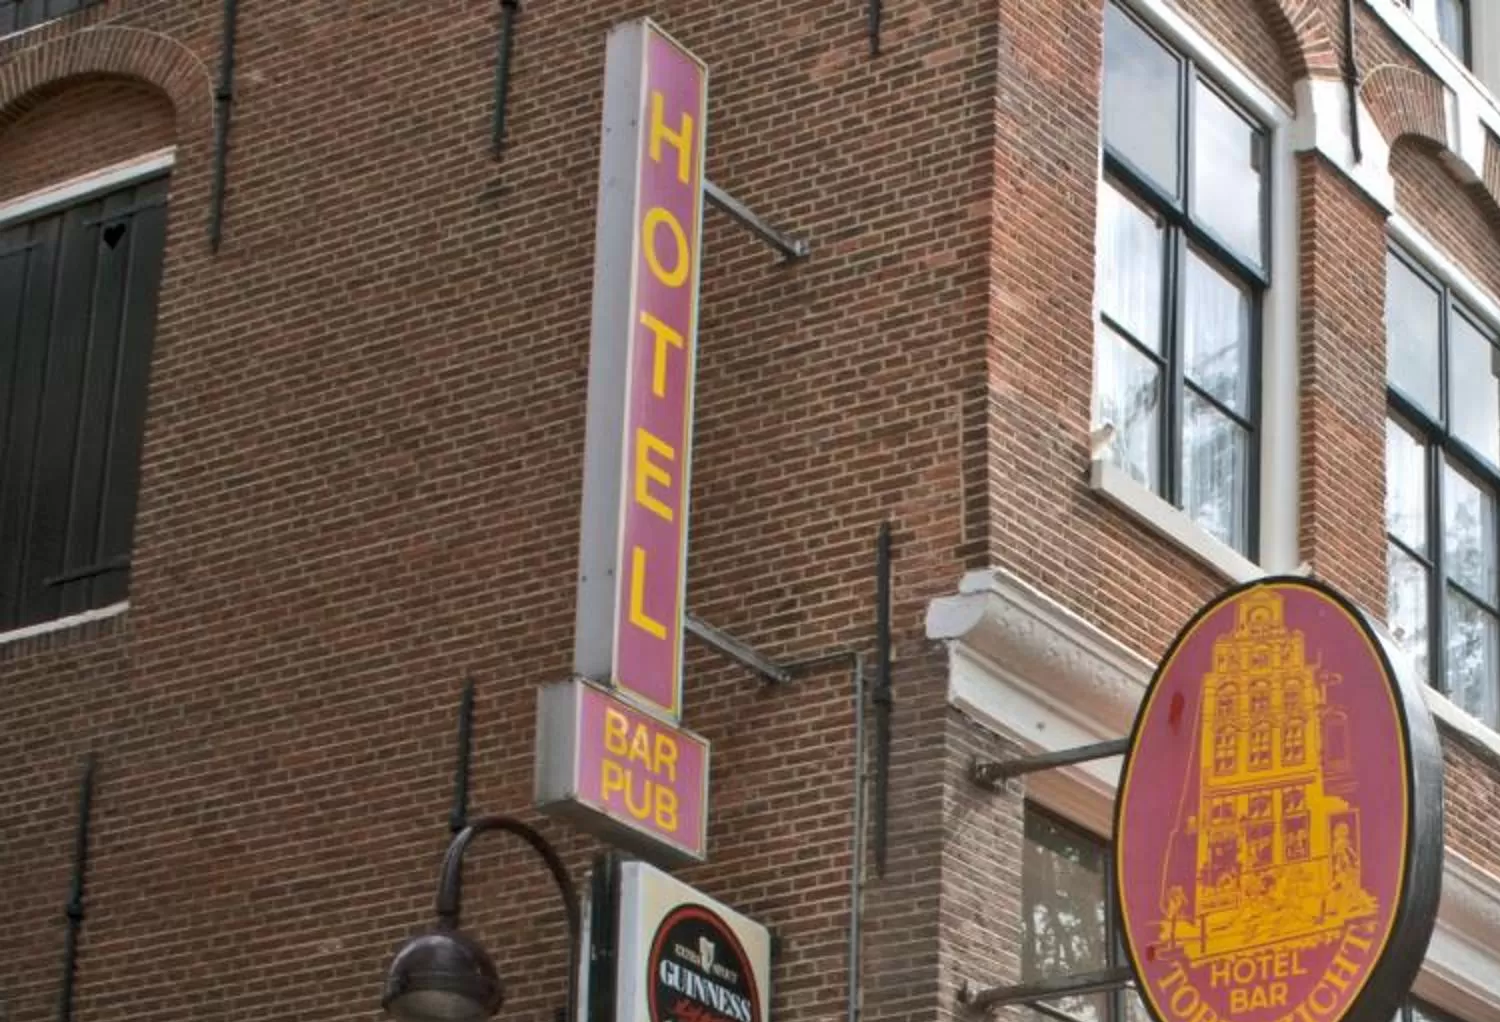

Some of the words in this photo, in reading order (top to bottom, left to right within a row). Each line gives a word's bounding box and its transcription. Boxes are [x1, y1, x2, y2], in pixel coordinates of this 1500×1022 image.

[628, 90, 693, 641] HOTEL
[604, 706, 678, 783] BAR
[602, 758, 678, 833] PUB
[1210, 952, 1308, 989] HOTEL
[1229, 982, 1288, 1014] BAR
